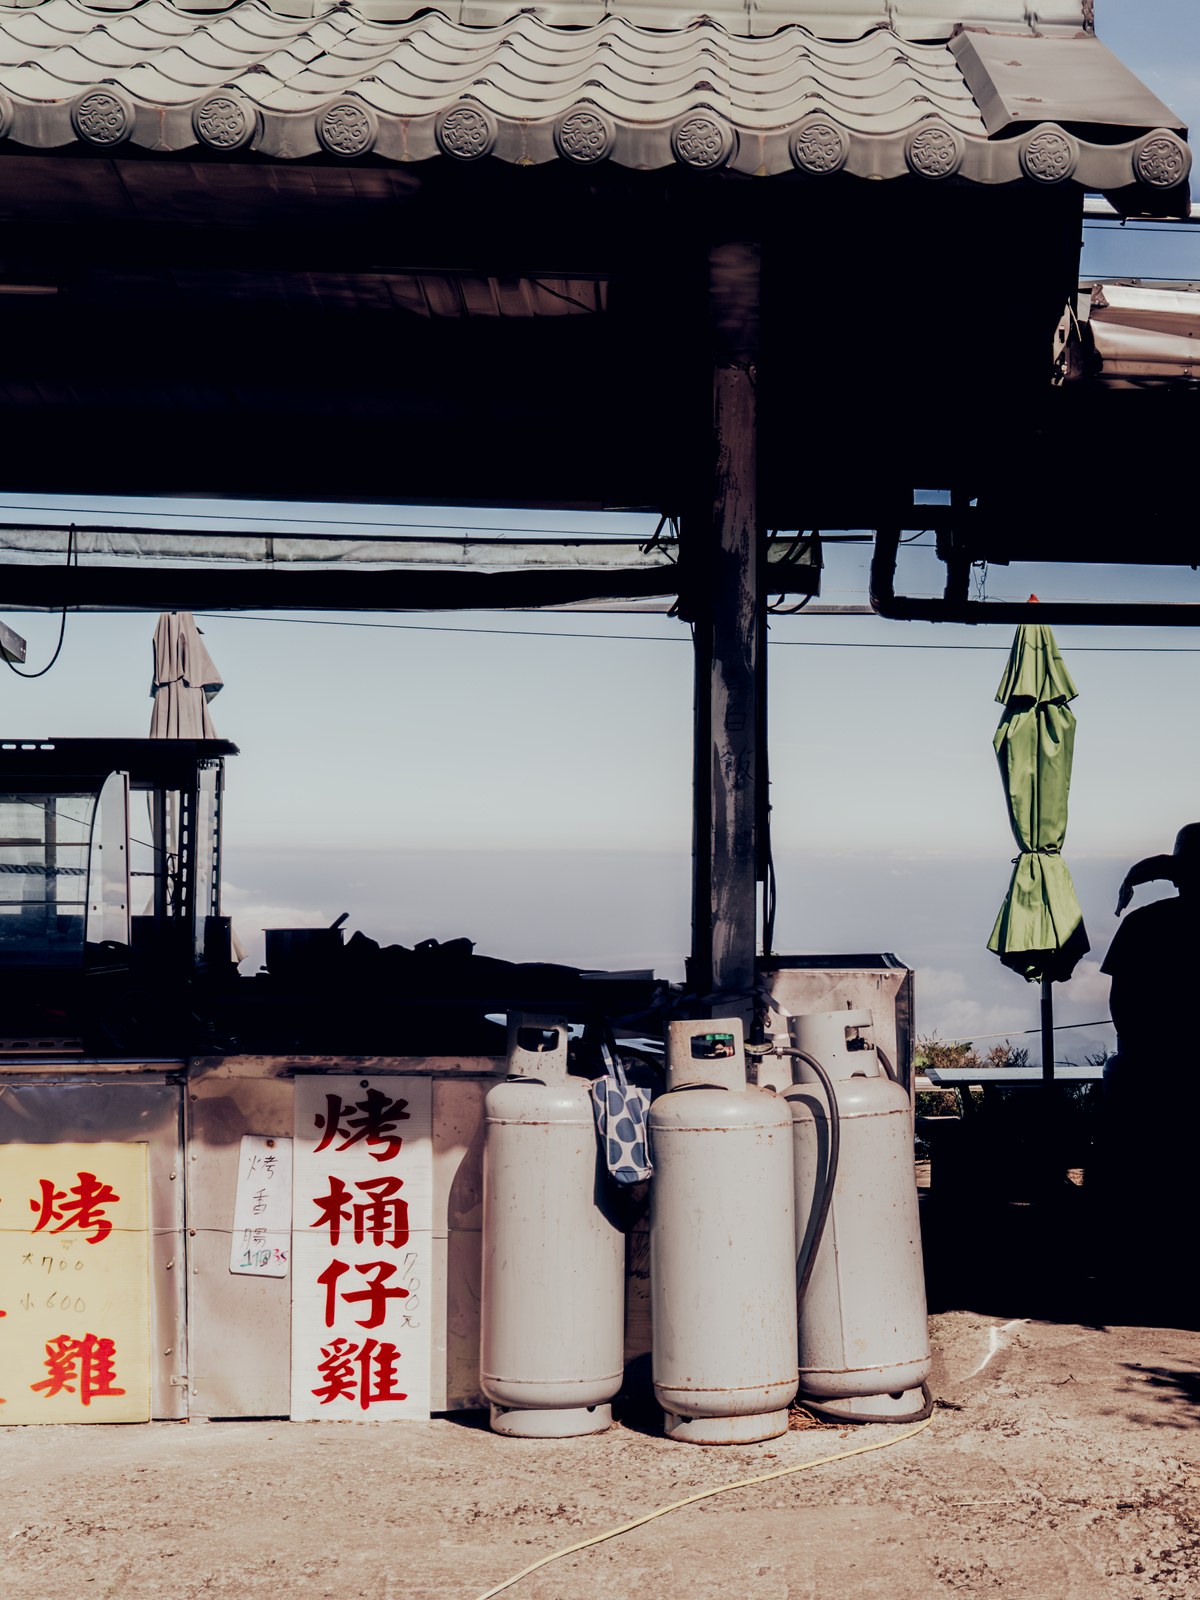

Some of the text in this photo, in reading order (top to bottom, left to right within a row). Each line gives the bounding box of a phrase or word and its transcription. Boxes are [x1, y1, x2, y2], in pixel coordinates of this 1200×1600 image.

[240, 1154, 280, 1249] 烤香腸
[309, 1087, 411, 1411] 烤桶仔雞
[400, 1252, 421, 1329] 700元
